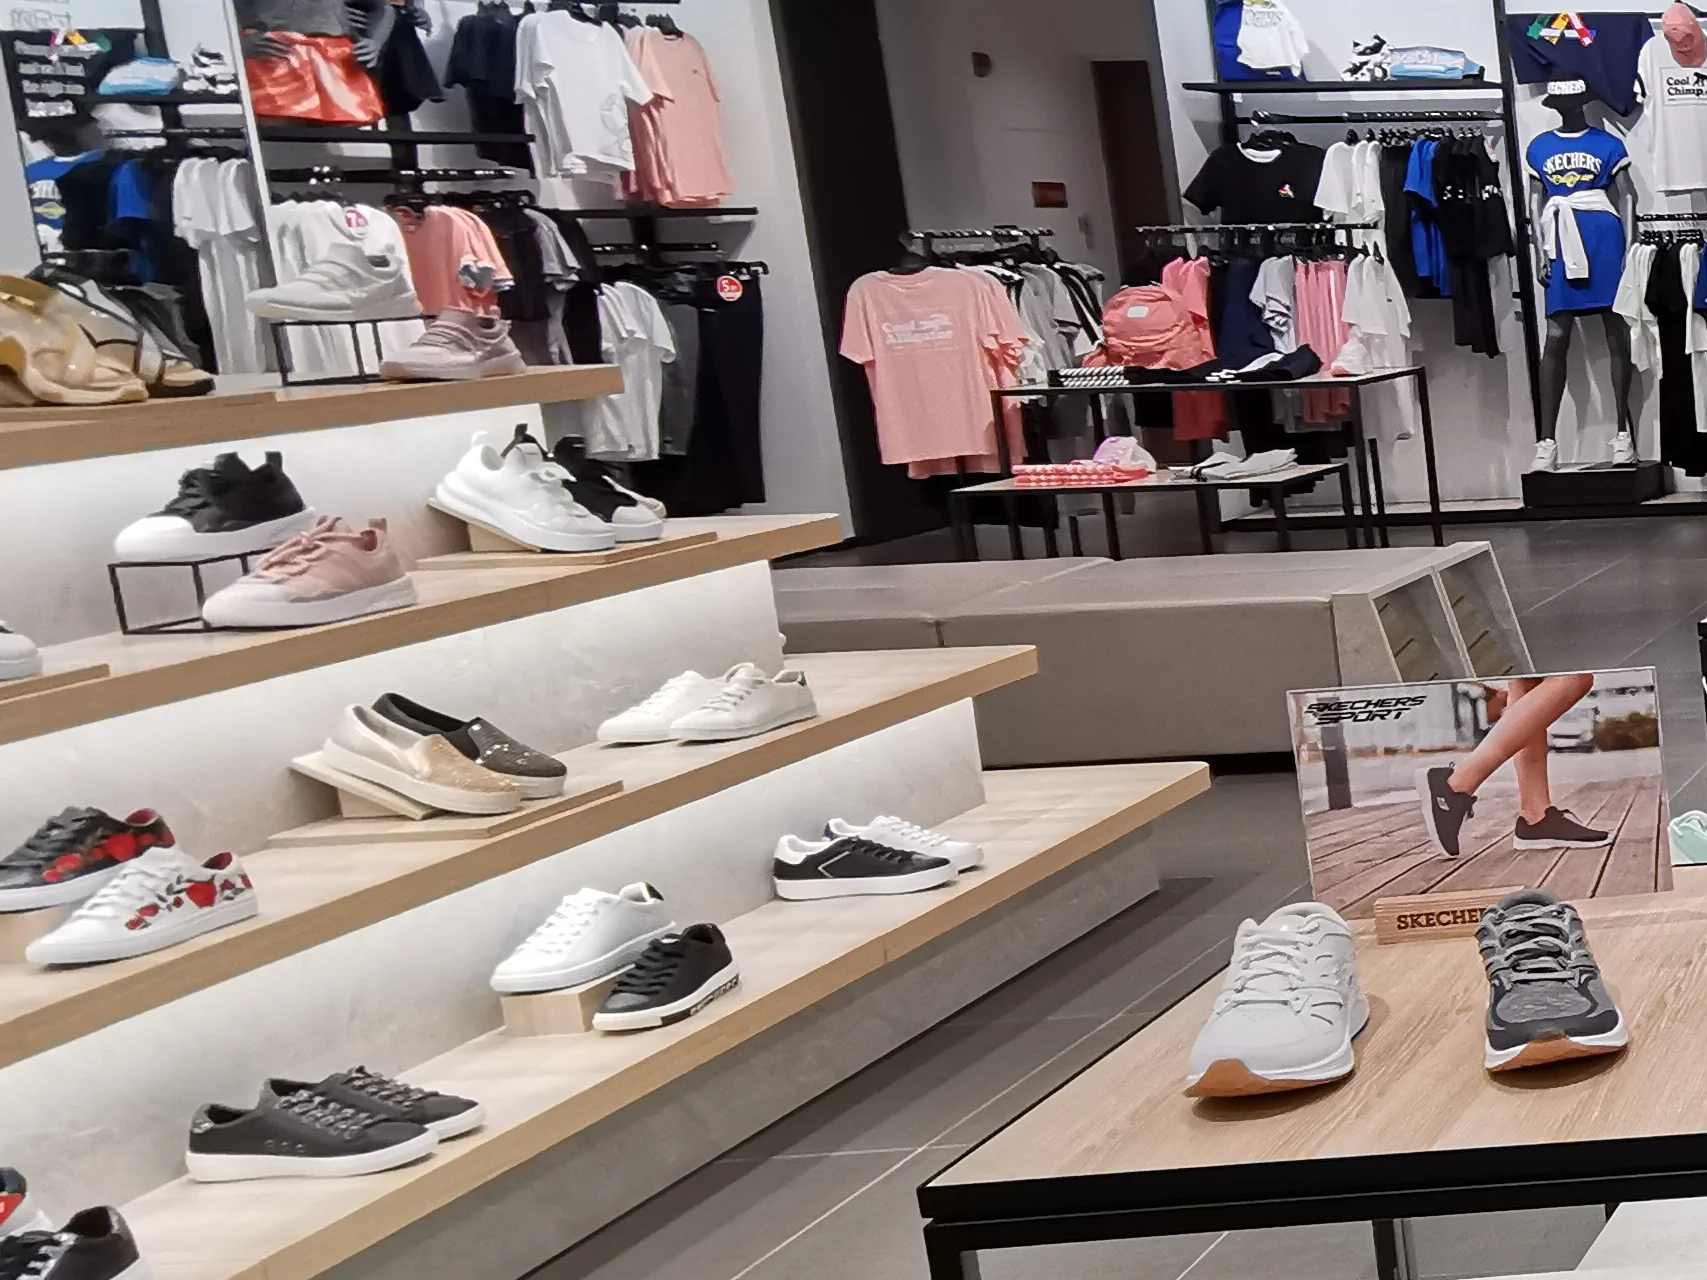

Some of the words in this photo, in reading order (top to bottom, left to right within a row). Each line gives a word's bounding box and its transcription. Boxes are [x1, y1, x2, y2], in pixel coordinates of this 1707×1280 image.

[1666, 76, 1689, 86] Cool
[1542, 152, 1603, 172] SKECHERS
[1304, 695, 1428, 714] SKECHERS
[1315, 707, 1412, 725] SPORT
